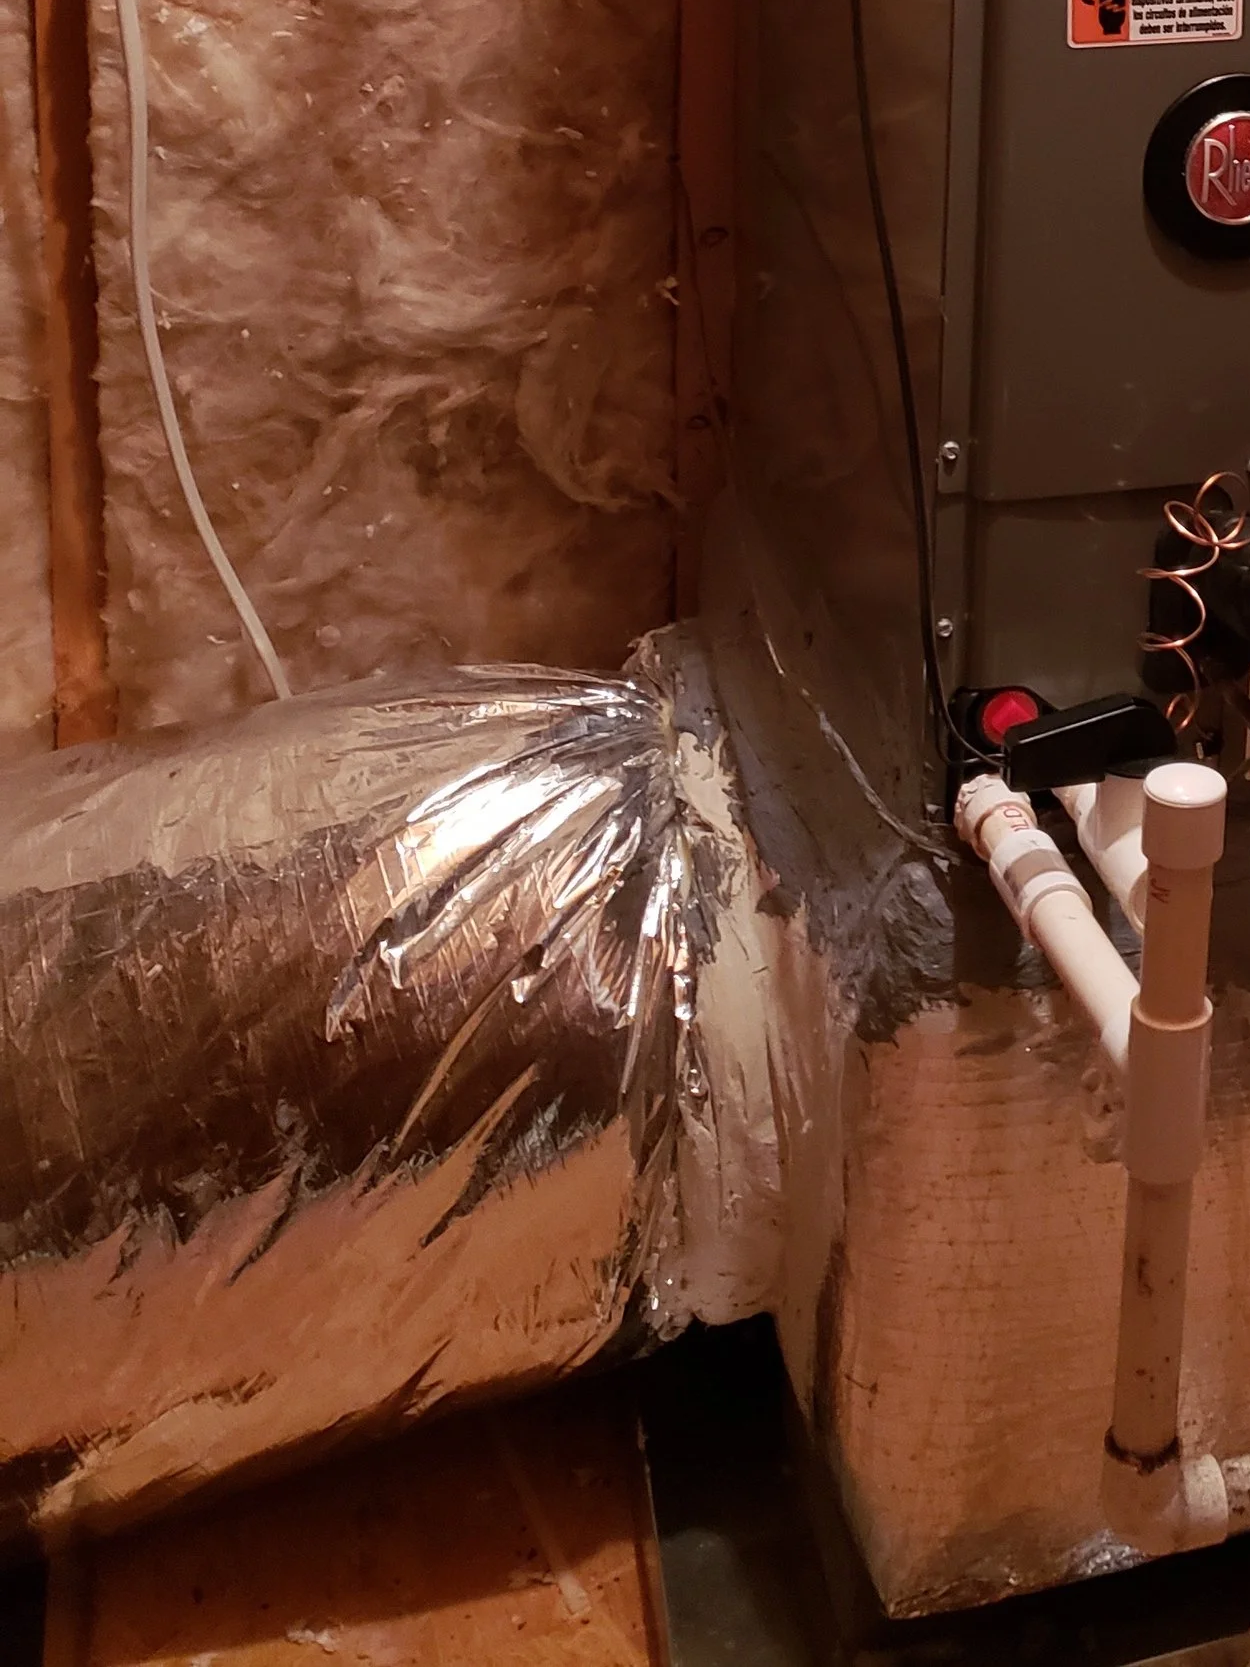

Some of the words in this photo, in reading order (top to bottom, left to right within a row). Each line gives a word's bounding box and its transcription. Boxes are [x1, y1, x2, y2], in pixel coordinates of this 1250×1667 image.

[1133, 10, 1143, 20] los
[1146, 8, 1176, 20] circuitos
[1178, 8, 1186, 18] de
[1189, 5, 1233, 17] alimentación
[1139, 23, 1161, 35] deben
[1163, 24, 1174, 33] ser
